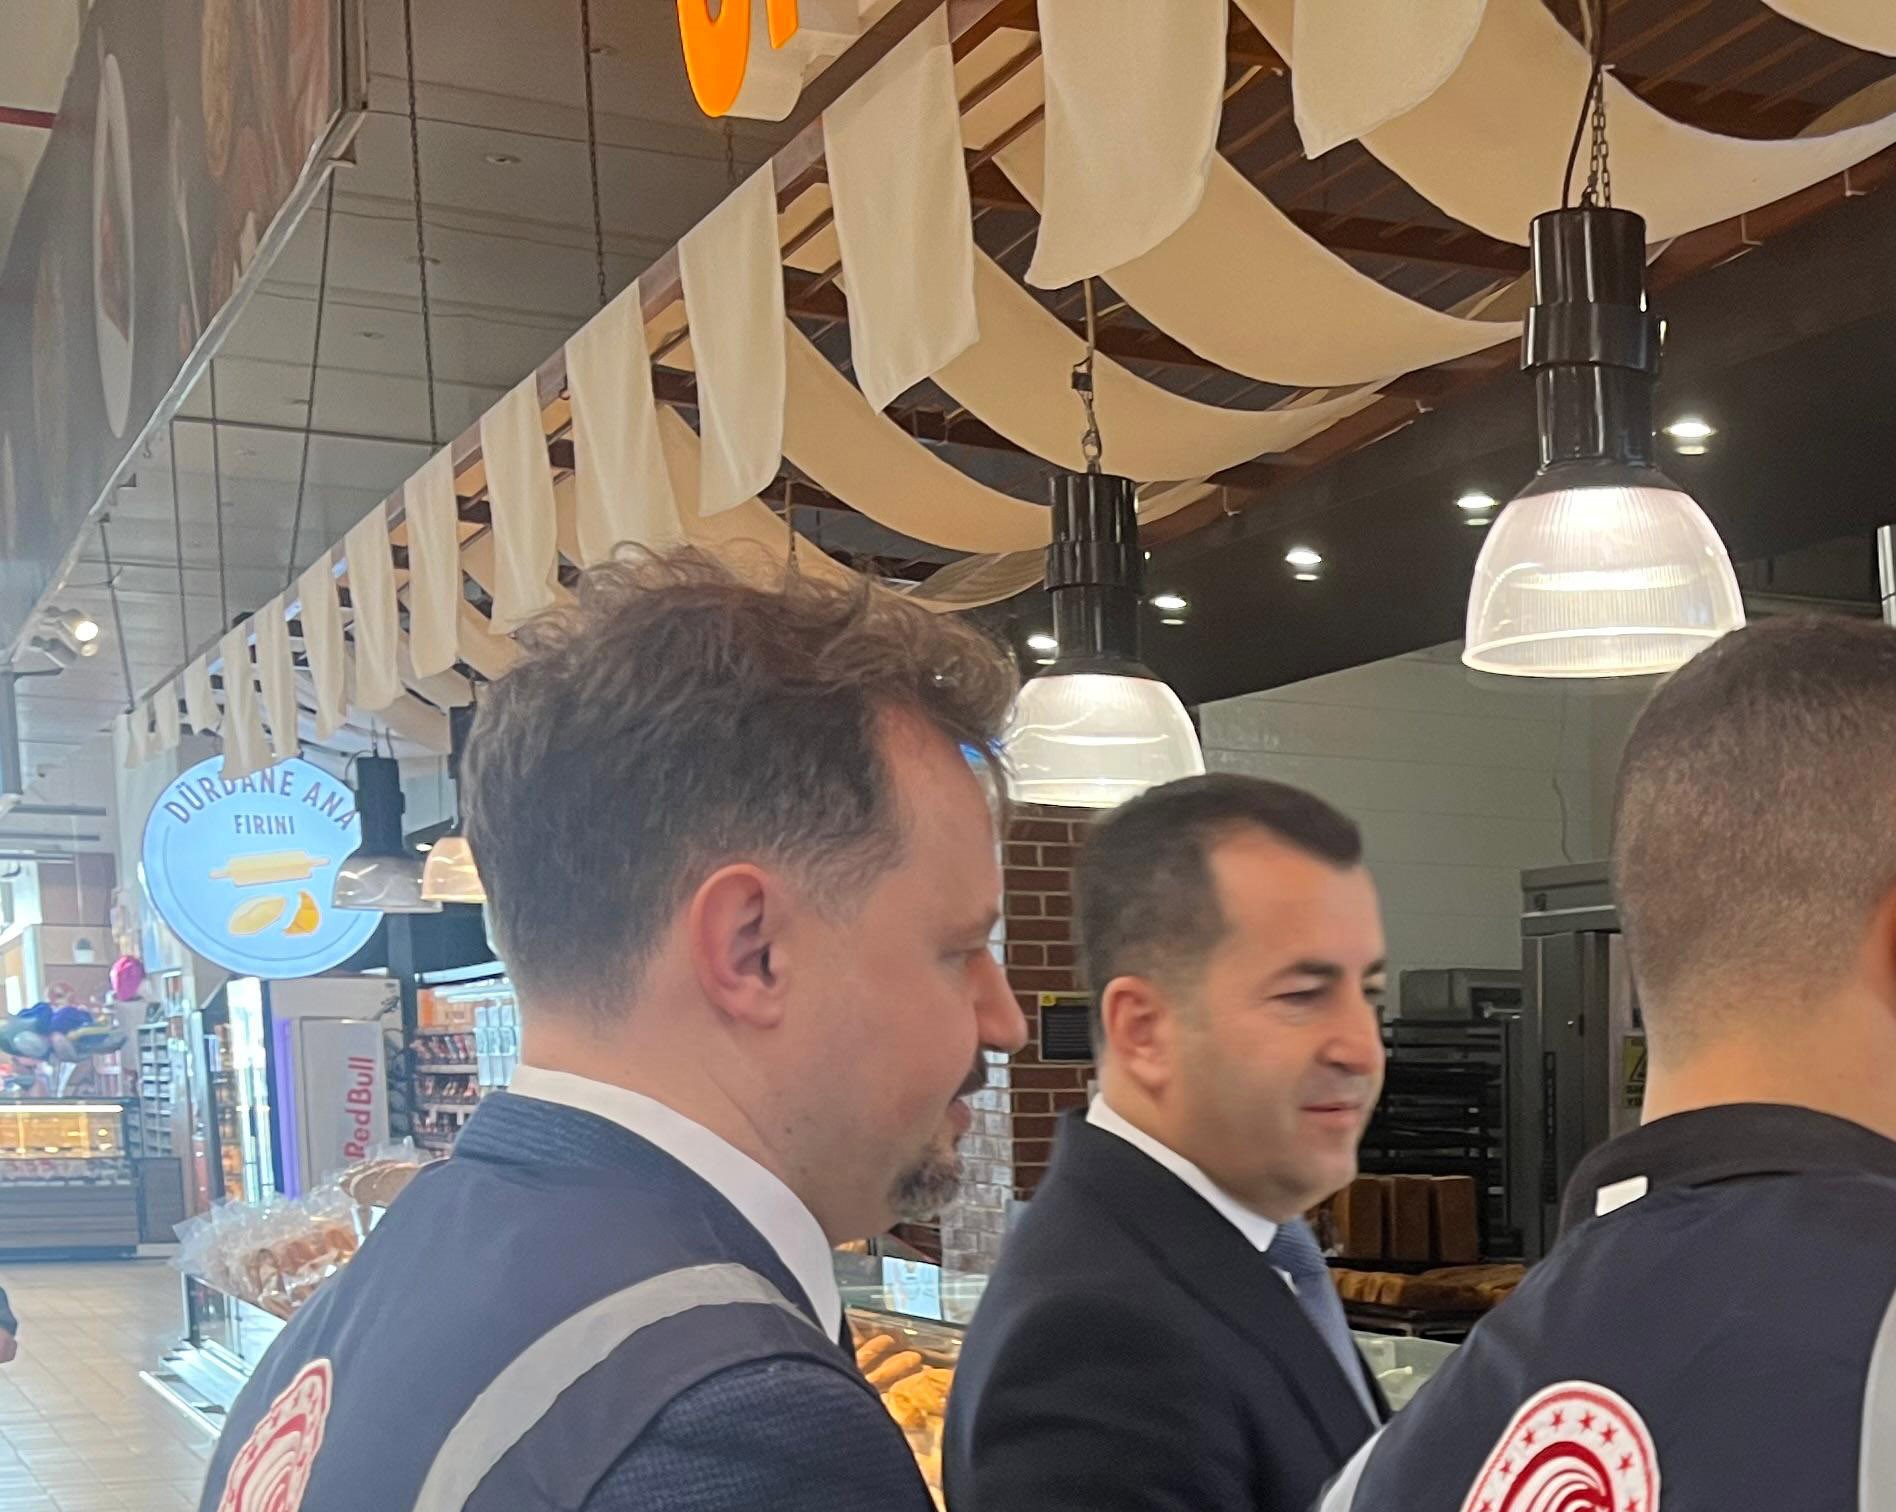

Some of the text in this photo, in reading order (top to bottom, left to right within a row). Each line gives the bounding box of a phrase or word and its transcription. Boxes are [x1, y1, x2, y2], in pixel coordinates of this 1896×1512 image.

[164, 766, 360, 831] DÜRDANE ANA
[234, 815, 296, 834] FIRINI
[343, 1056, 377, 1160] Red Bull
